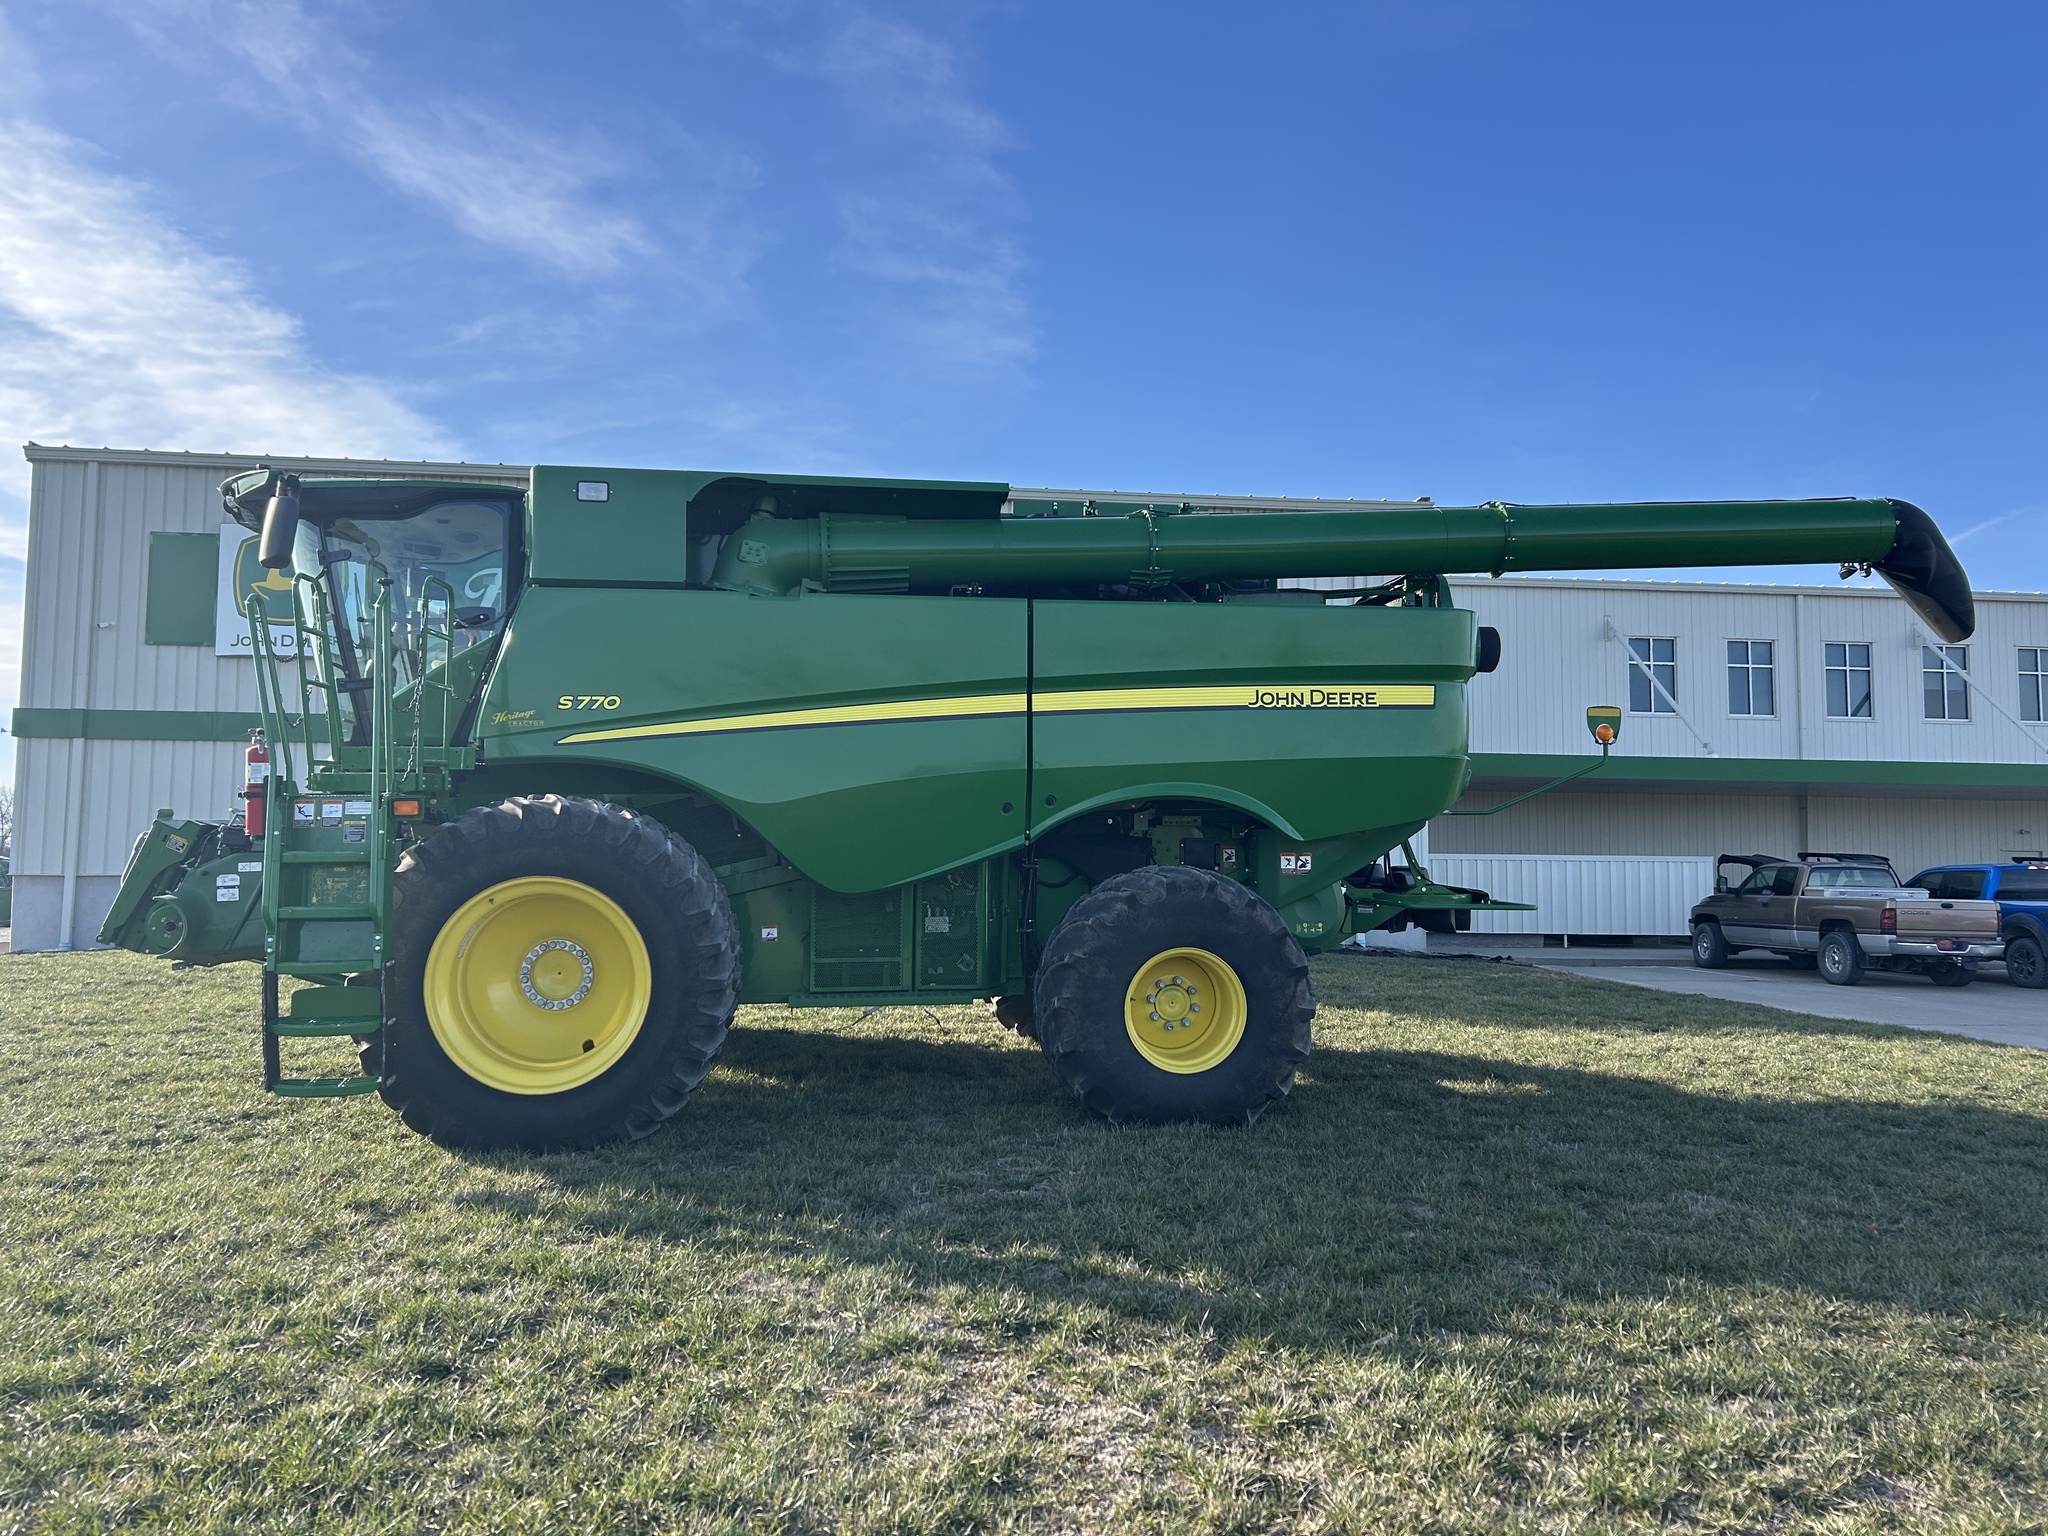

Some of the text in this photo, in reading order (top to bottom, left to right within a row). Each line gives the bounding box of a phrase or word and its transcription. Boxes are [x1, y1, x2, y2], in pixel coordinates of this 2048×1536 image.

[557, 695, 622, 710] S770
[1248, 689, 1378, 706] JOHN DEERE
[490, 709, 536, 725] Heritage
